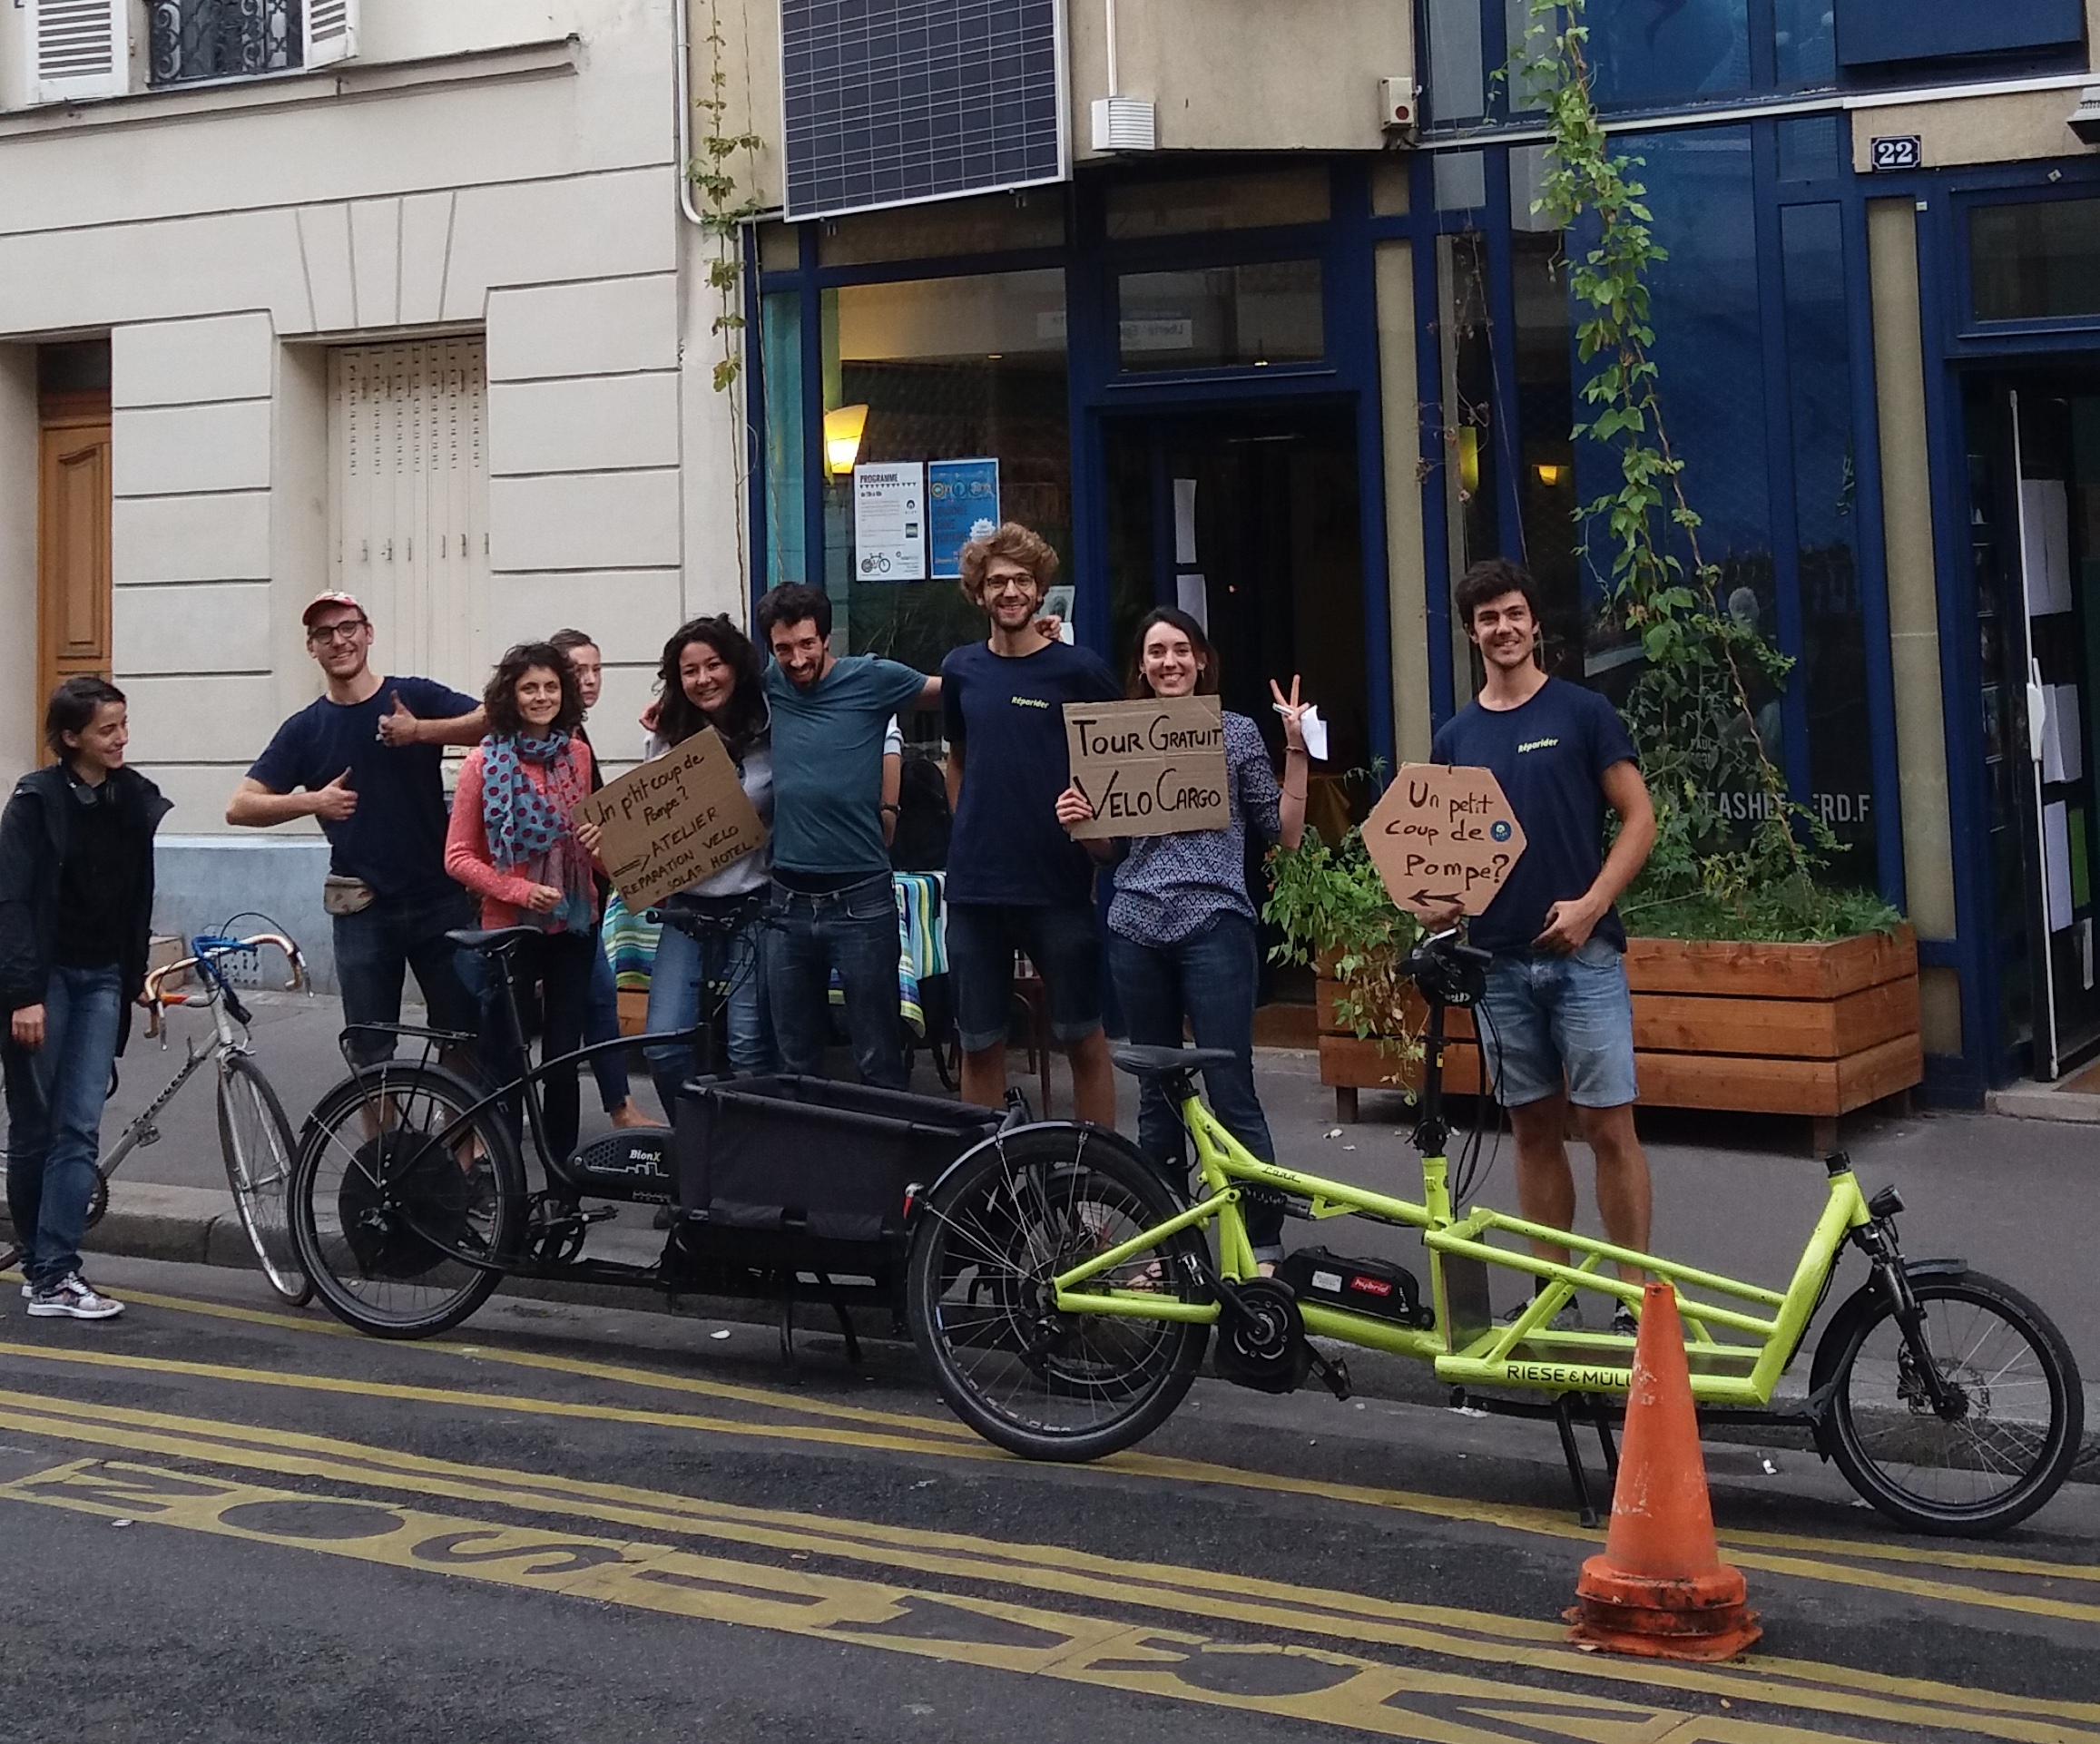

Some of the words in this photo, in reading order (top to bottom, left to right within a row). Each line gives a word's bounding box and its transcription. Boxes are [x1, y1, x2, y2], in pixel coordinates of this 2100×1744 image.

[1878, 142, 1913, 164] 22
[859, 473, 898, 484] PROGRAMME
[1148, 714, 1223, 751] GRATUIT
[584, 800, 616, 828] Un
[650, 766, 682, 790] coup
[683, 754, 705, 769] de
[1156, 768, 1222, 811] CARGO
[1408, 780, 1439, 808] Un
[1449, 791, 1495, 823] petit
[643, 799, 681, 826] Pompe
[651, 807, 718, 857] ATELIER
[1450, 818, 1486, 841] de
[620, 849, 695, 900] REPARATION
[702, 825, 740, 850] VELO
[667, 865, 706, 892] SOLAR
[710, 842, 754, 868] HOTEL
[1403, 853, 1510, 891] Pompe?
